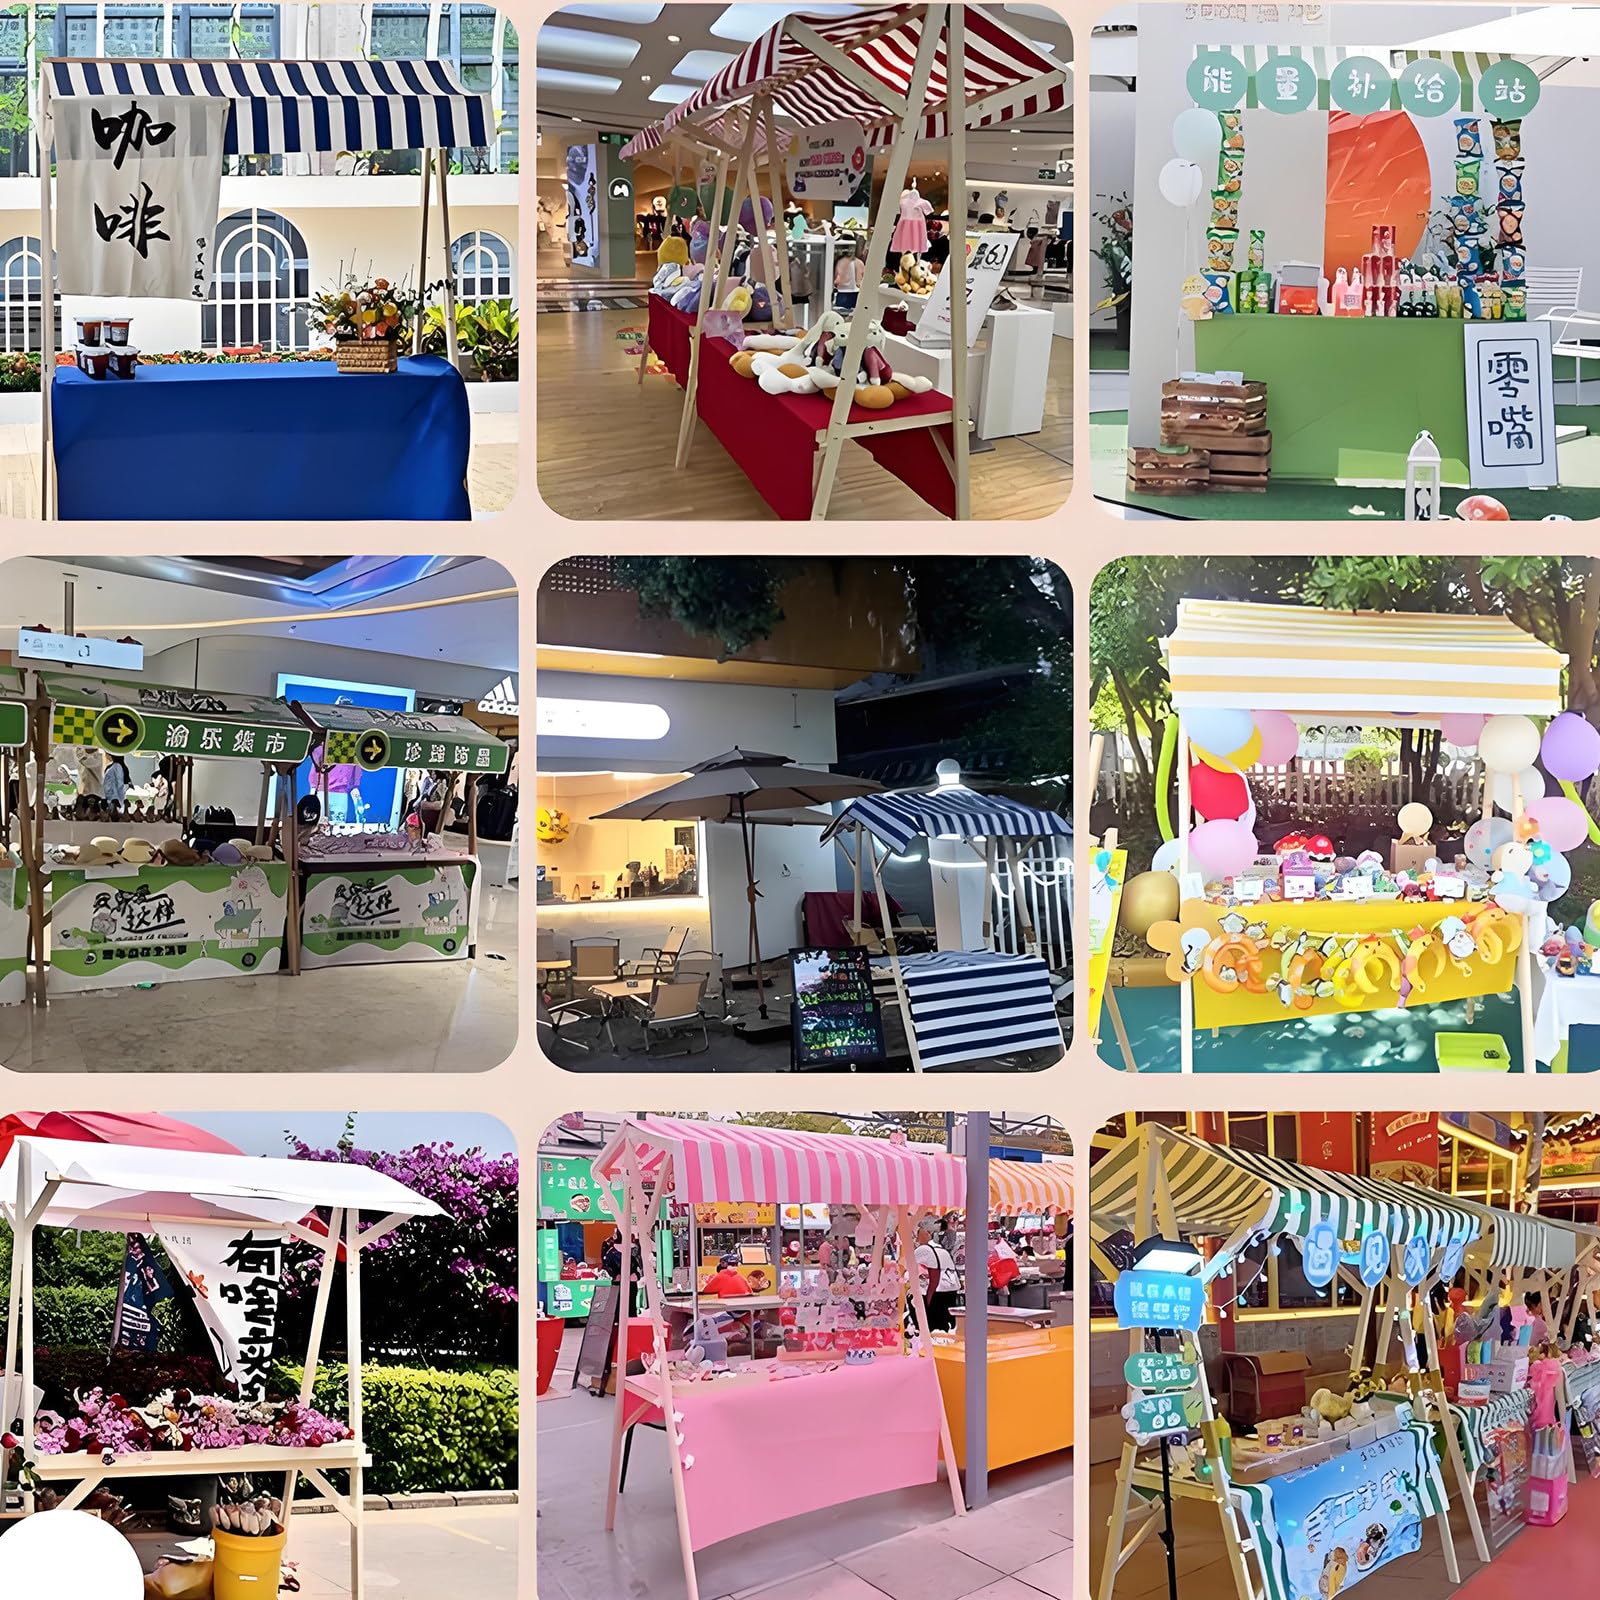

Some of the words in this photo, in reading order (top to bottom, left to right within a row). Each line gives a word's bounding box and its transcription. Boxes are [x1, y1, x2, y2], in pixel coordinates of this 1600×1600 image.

[1203, 65, 1526, 104] 能量补给站
[91, 100, 177, 259] 咖啡
[1487, 351, 1534, 450] 零嘴
